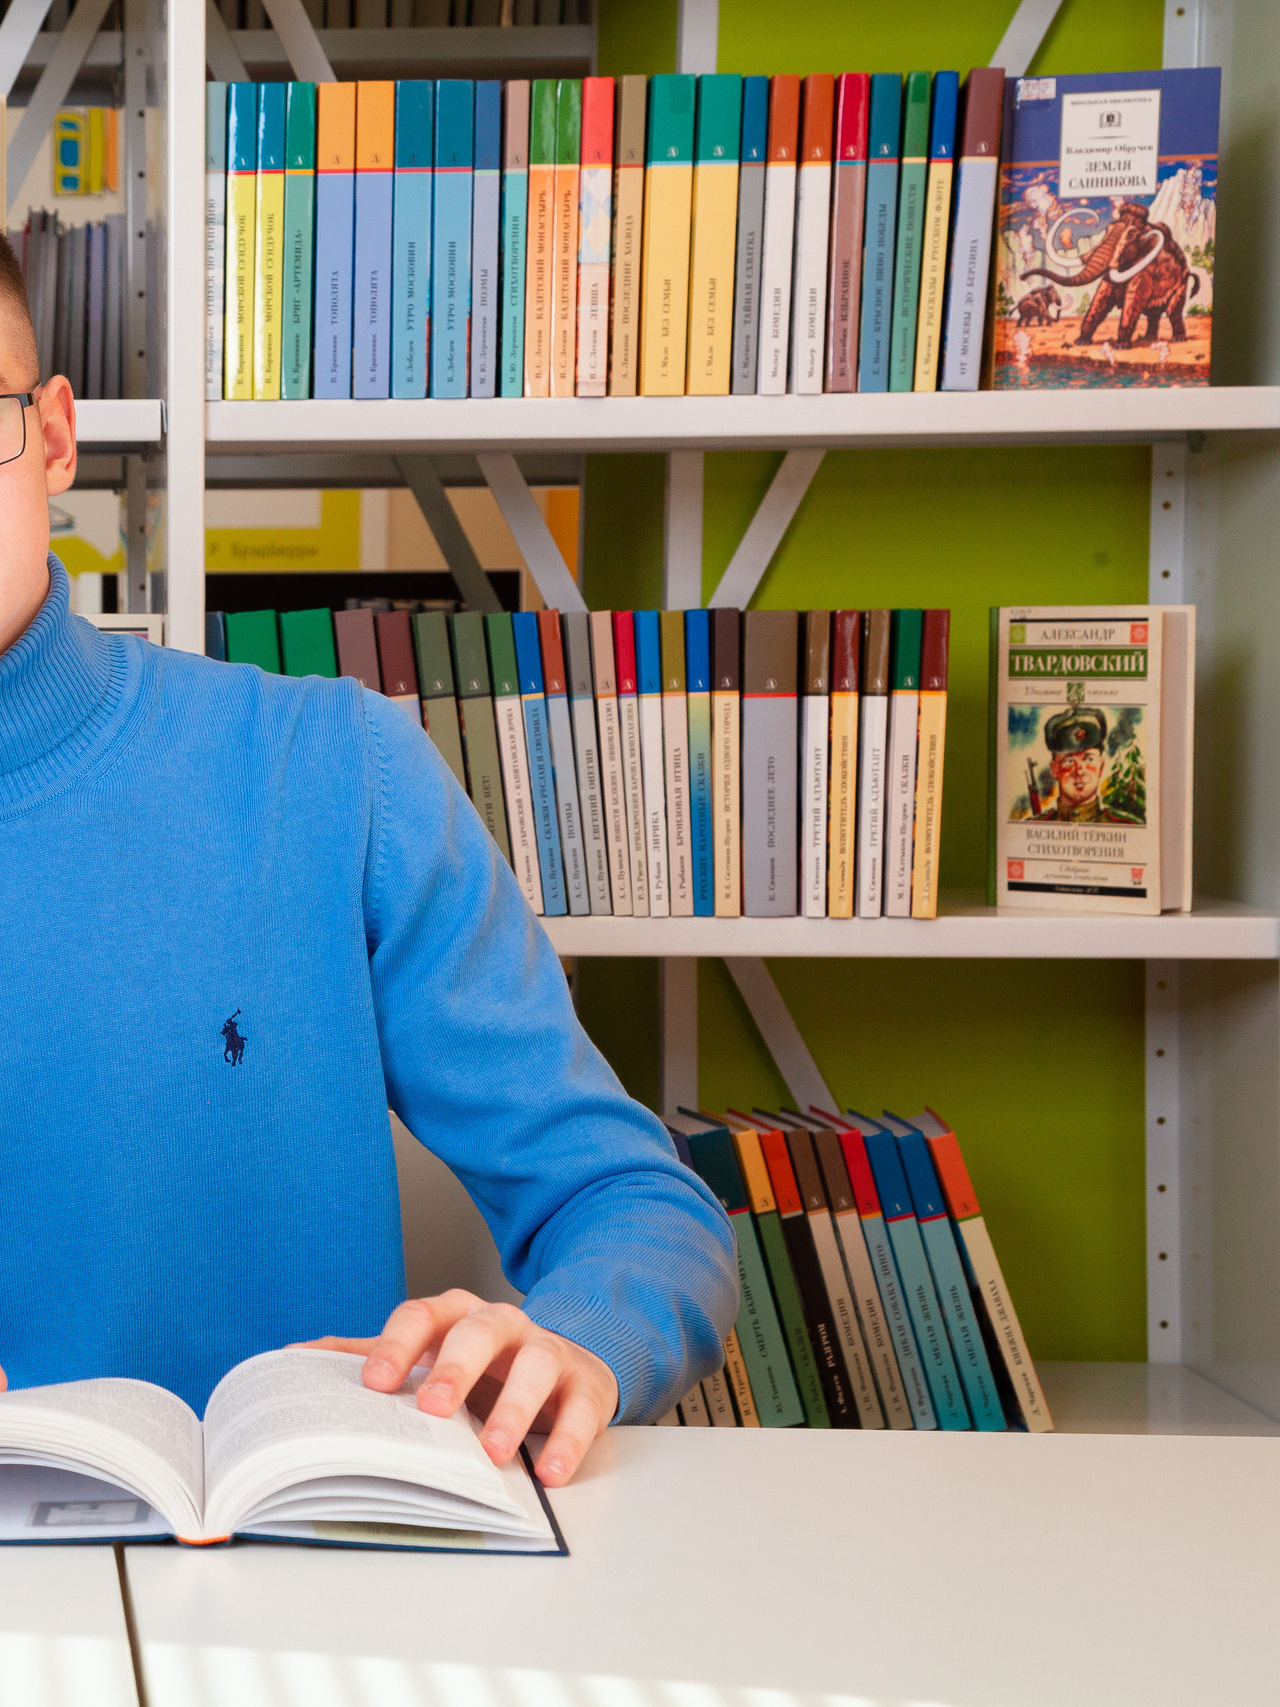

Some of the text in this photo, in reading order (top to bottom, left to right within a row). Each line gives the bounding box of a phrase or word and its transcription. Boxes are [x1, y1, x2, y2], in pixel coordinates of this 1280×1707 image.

[1066, 144, 1153, 155] Владимир Обручев
[1085, 160, 1131, 172] ЗЕМЛЯ
[1069, 175, 1147, 188] САННИКОВА
[510, 216, 519, 306] СТИХОТВОРЕНИЯ
[536, 190, 546, 319] КАДЕТСКИЙ МОНАСТЫРЬ
[625, 215, 634, 255] ХОЛОДА
[237, 215, 246, 324] МОРСКОЙ СУНДУЧОК
[407, 242, 416, 330] УТРО МОСКОВИИ
[742, 231, 755, 324] ТАЙНАЯ СХВАТКА
[293, 297, 301, 324] БРИГ
[331, 271, 339, 325] ТОПОЛЯТА
[370, 270, 378, 324] ТОПОЛЯТА
[772, 288, 781, 338] КОМЕДИИ
[960, 239, 978, 374] ОТ МОСКВЫ ДО БЕРЛИНА
[1041, 629, 1115, 640] АЛЕКСАНДР
[1011, 652, 1145, 673] ТВАРДОВСКИЙ
[507, 708, 529, 848] ДУБРОВСКИЙ КАПИТАНСКАЯ ДОЧКА
[586, 749, 600, 840] ЕВГЕНИЙ ОНЕГИН
[673, 747, 684, 846] БРОНЗОВАЯ ПТИЦА
[767, 757, 776, 848] ПОСЛЕДНЕЕ ЛЕТО
[652, 811, 661, 852] ЛИРИКА
[1026, 828, 1126, 843] ВАСИЛИЙ ТЁРКИН
[1027, 843, 1124, 858] СТИХОТВОРЕНИЯ
[876, 1244, 910, 1359] ДИКАЯ СОБАКА ДИНГО
[988, 1279, 1009, 1322] ДЖАВАХА
[817, 1324, 836, 1367] РАЗГРОМ
